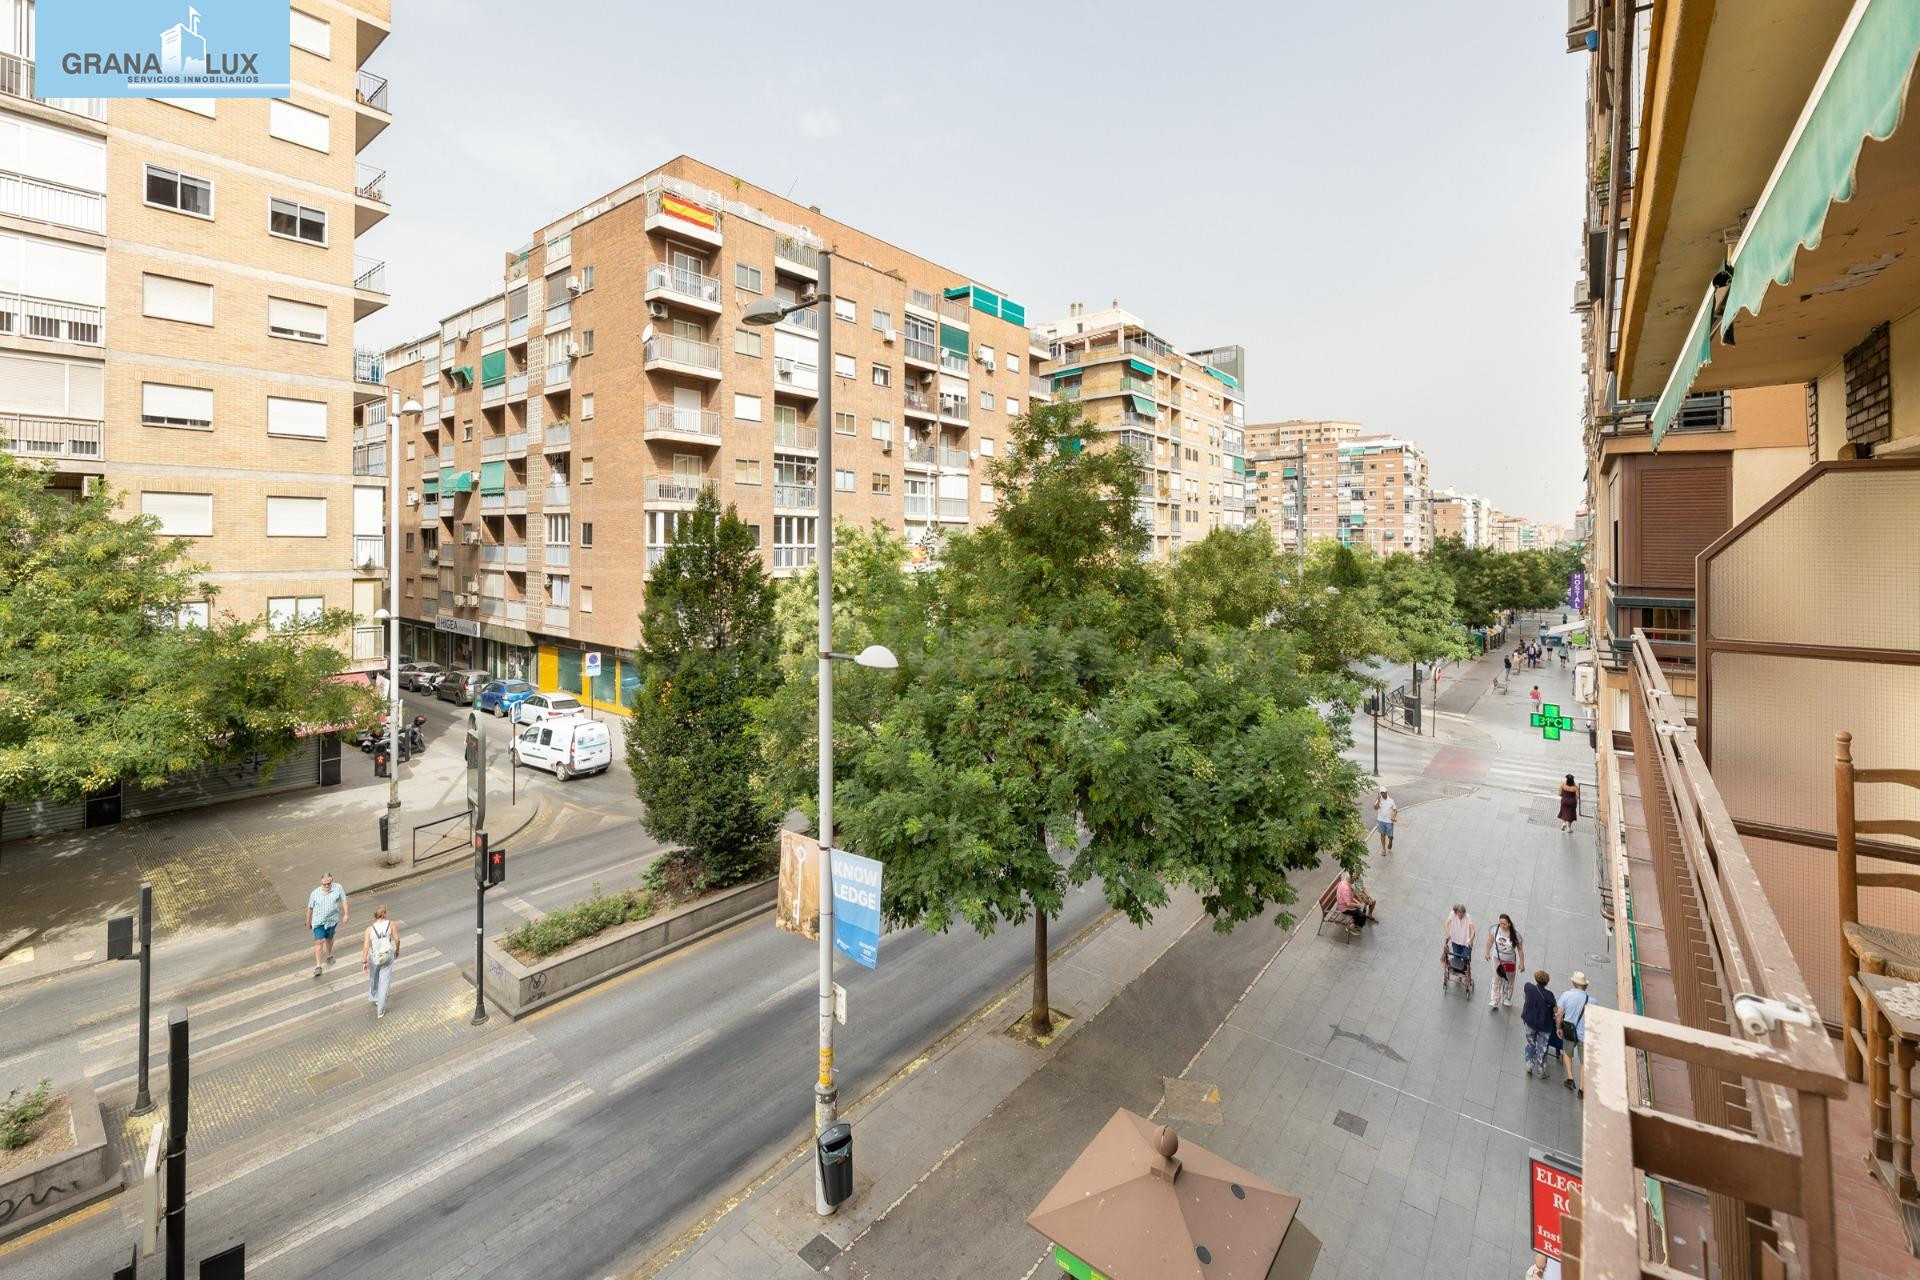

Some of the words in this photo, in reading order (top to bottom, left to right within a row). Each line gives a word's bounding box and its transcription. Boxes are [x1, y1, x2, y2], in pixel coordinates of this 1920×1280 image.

[440, 616, 458, 630] HIGEA
[833, 860, 878, 887] KNOW
[834, 880, 876, 910] LEDGE
